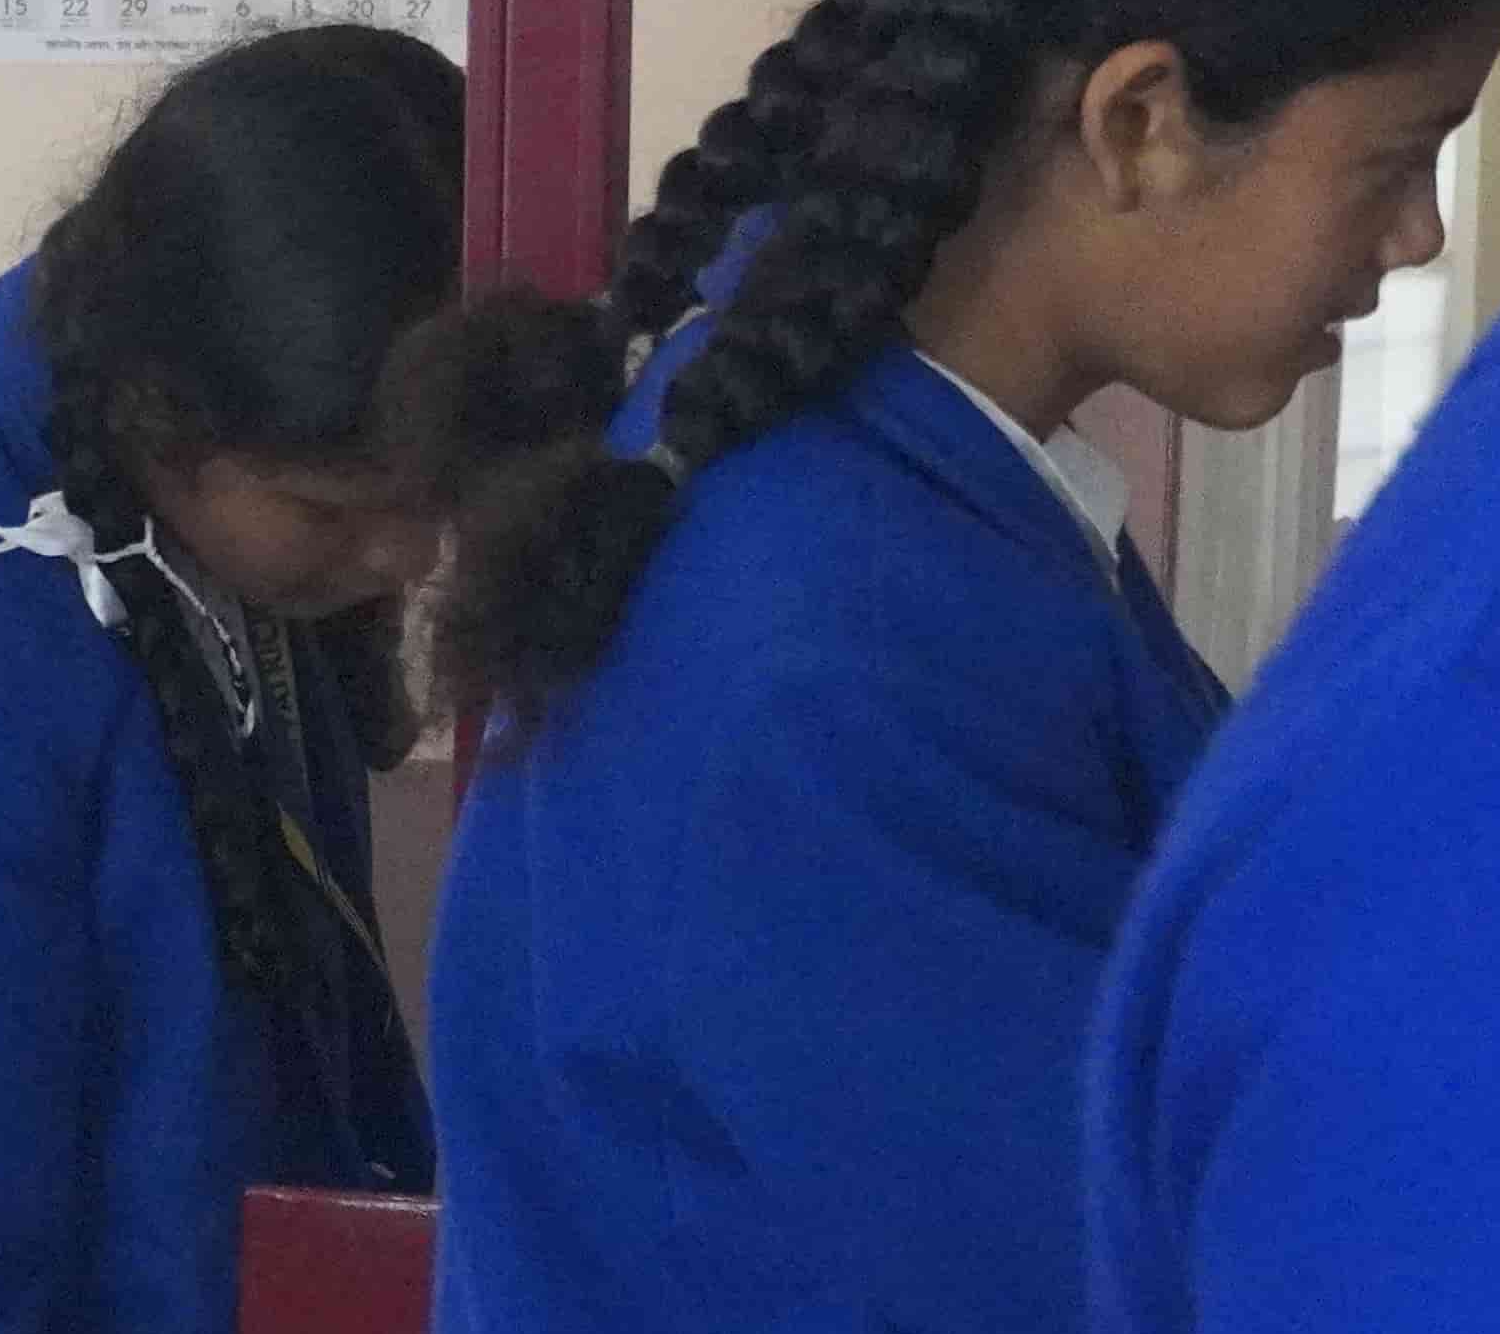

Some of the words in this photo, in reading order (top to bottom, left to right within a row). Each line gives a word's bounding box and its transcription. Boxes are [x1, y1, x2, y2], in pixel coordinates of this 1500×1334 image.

[235, 0, 251, 18] 6
[347, 0, 375, 18] 20
[405, 0, 432, 18] 27
